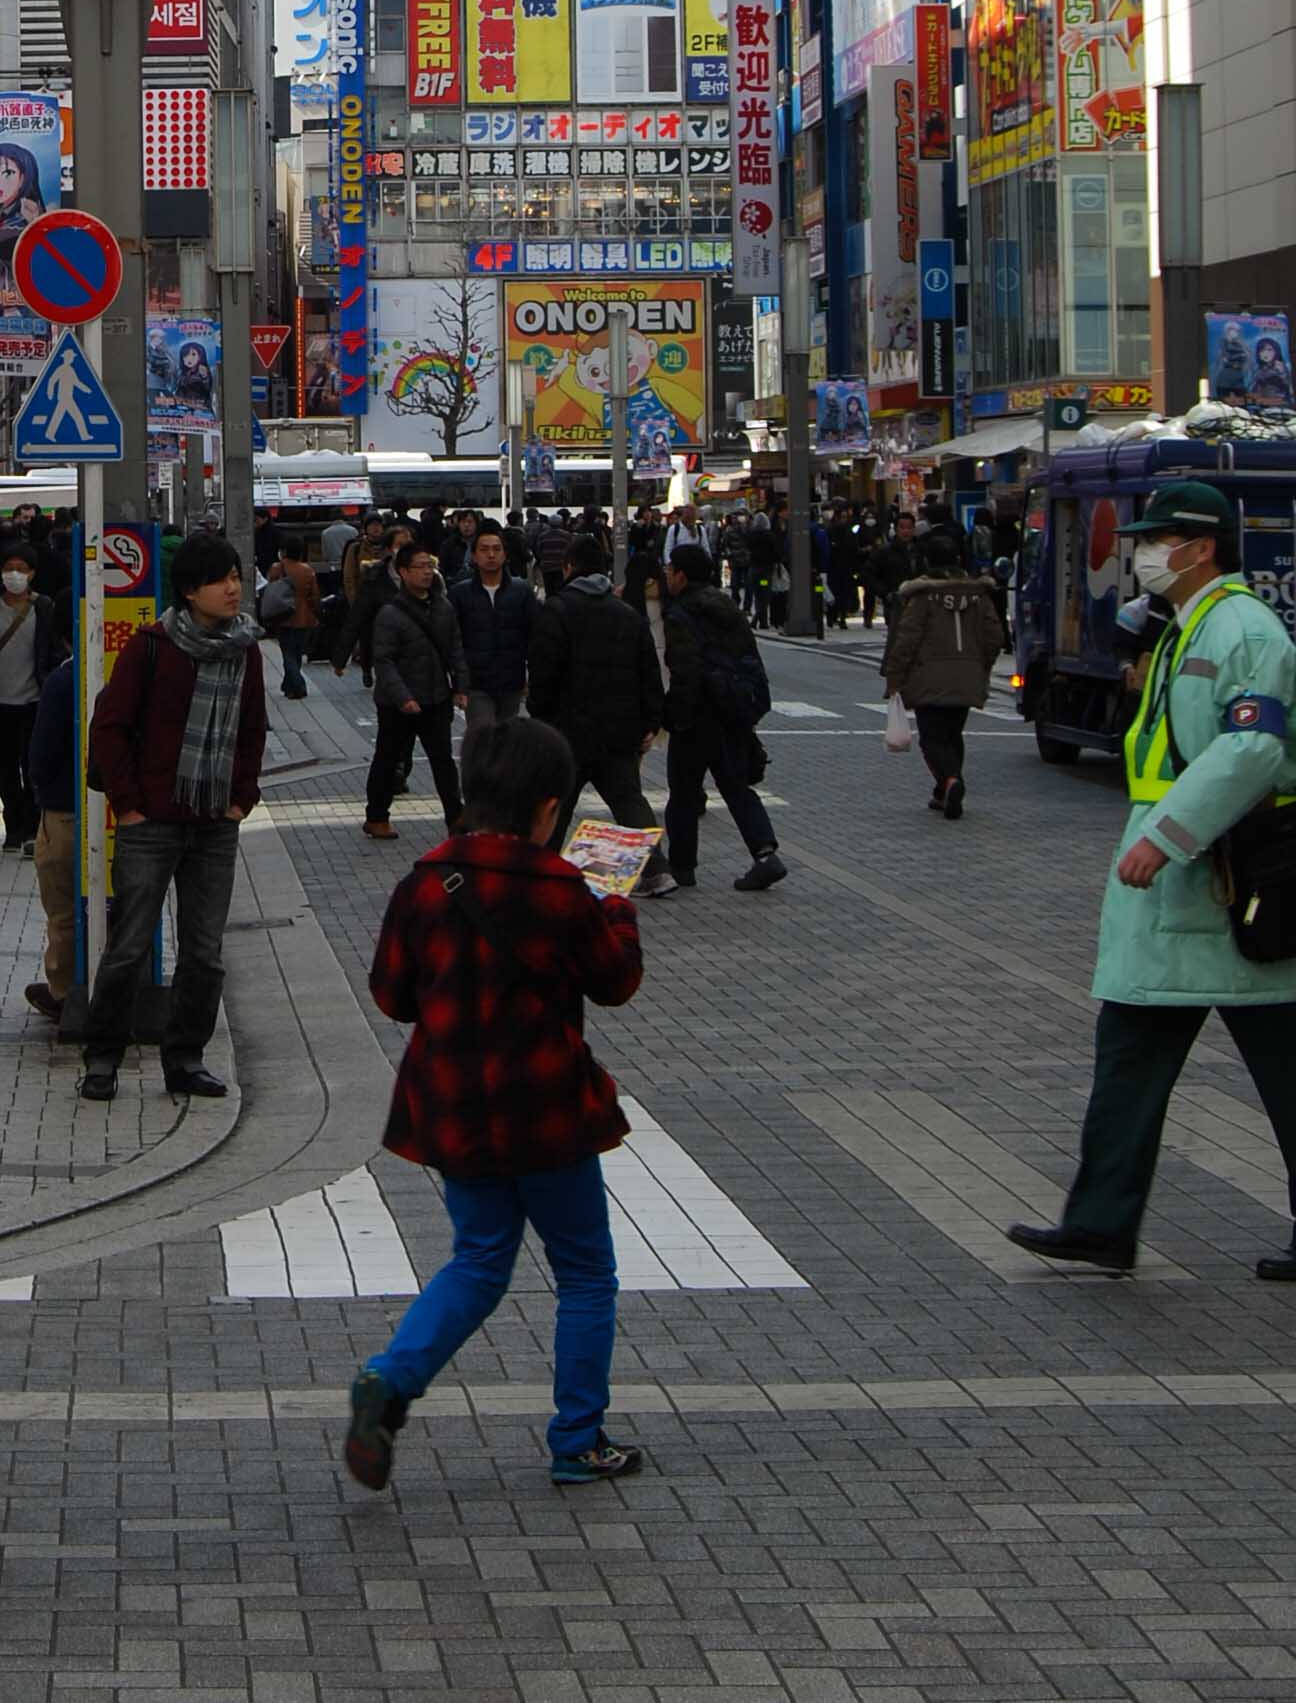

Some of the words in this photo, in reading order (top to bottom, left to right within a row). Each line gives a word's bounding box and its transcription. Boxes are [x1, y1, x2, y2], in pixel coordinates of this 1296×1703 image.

[415, 71, 455, 99] B1F
[341, 95, 362, 224] ONODEN
[895, 78, 921, 265] GAMERS
[474, 243, 514, 271] 4F
[635, 242, 684, 271] LED
[563, 288, 628, 302] Welcome
[630, 288, 647, 301] to
[340, 246, 365, 396] オノデン
[253, 334, 282, 345] 止まれ
